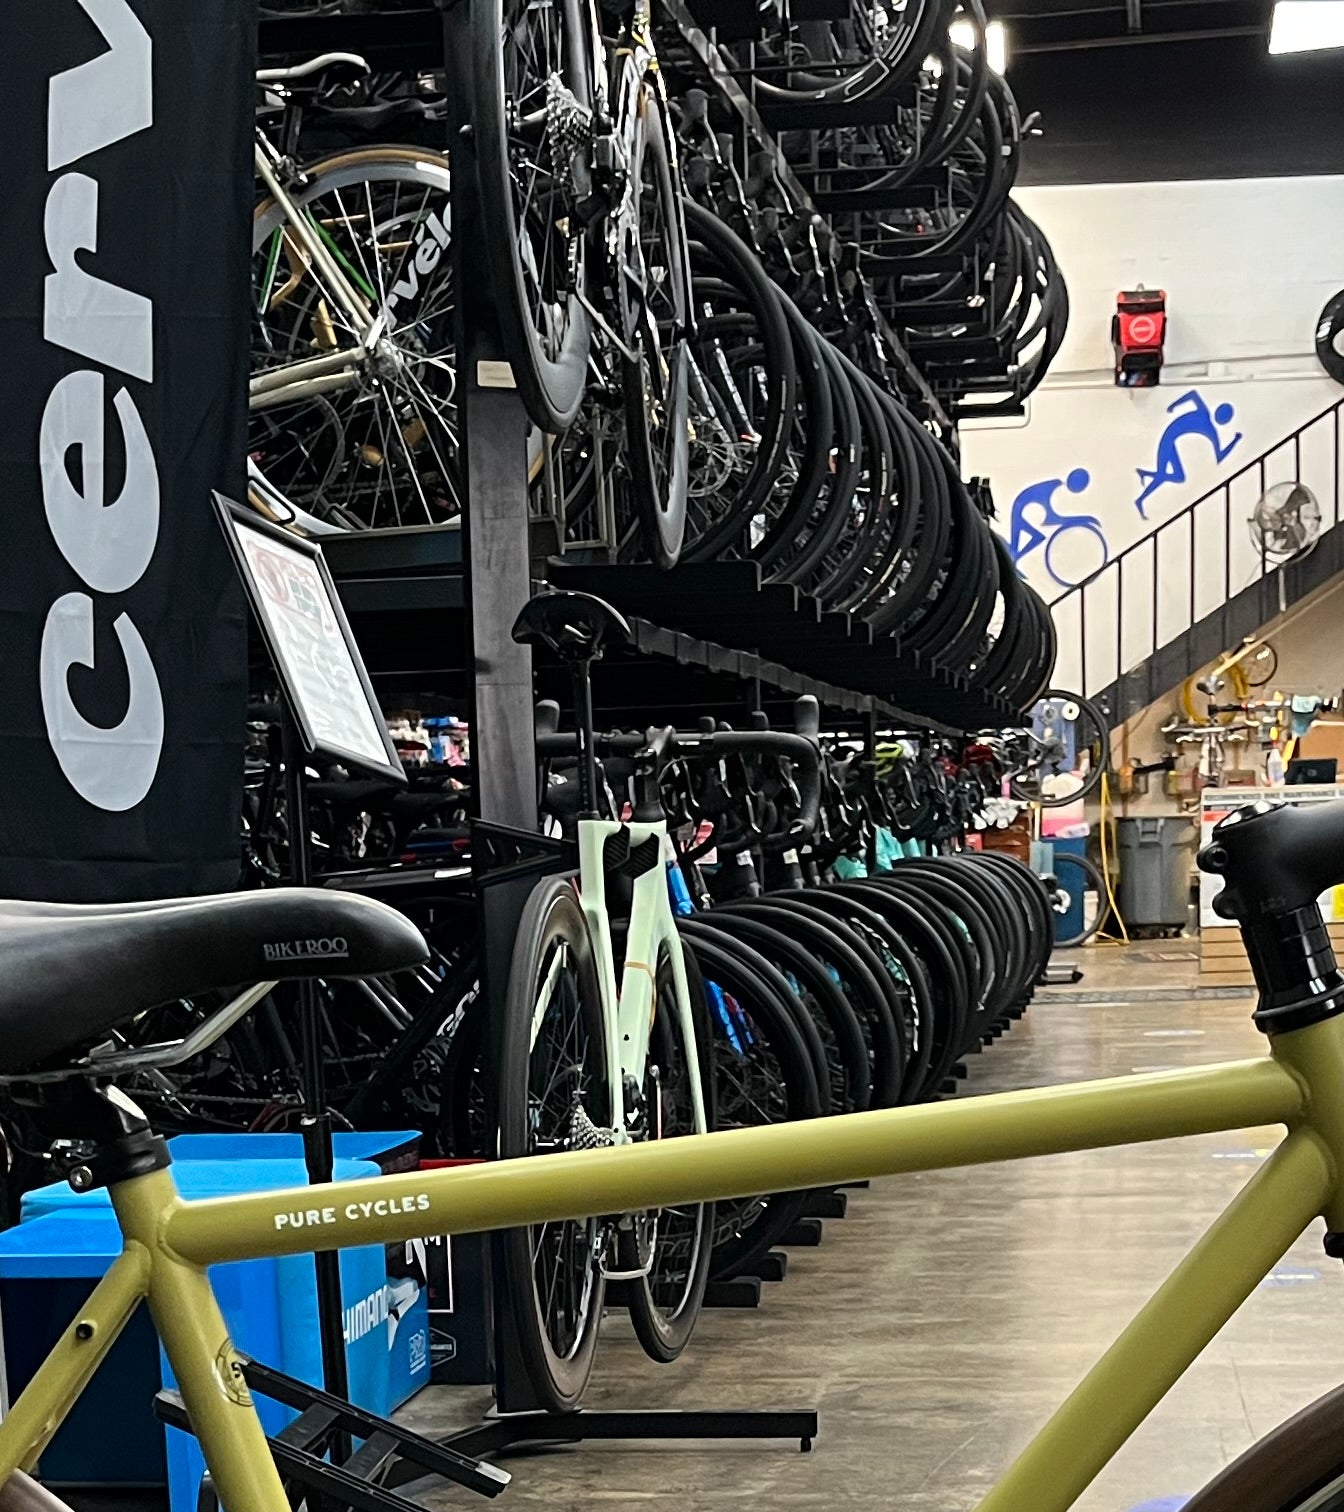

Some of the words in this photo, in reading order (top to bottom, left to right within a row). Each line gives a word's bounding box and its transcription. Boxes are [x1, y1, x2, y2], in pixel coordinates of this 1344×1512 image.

[263, 937, 348, 959] BIKEROO
[274, 1207, 336, 1230] PURE
[345, 1194, 431, 1220] CYCLES
[343, 1284, 389, 1345] HIMAN
